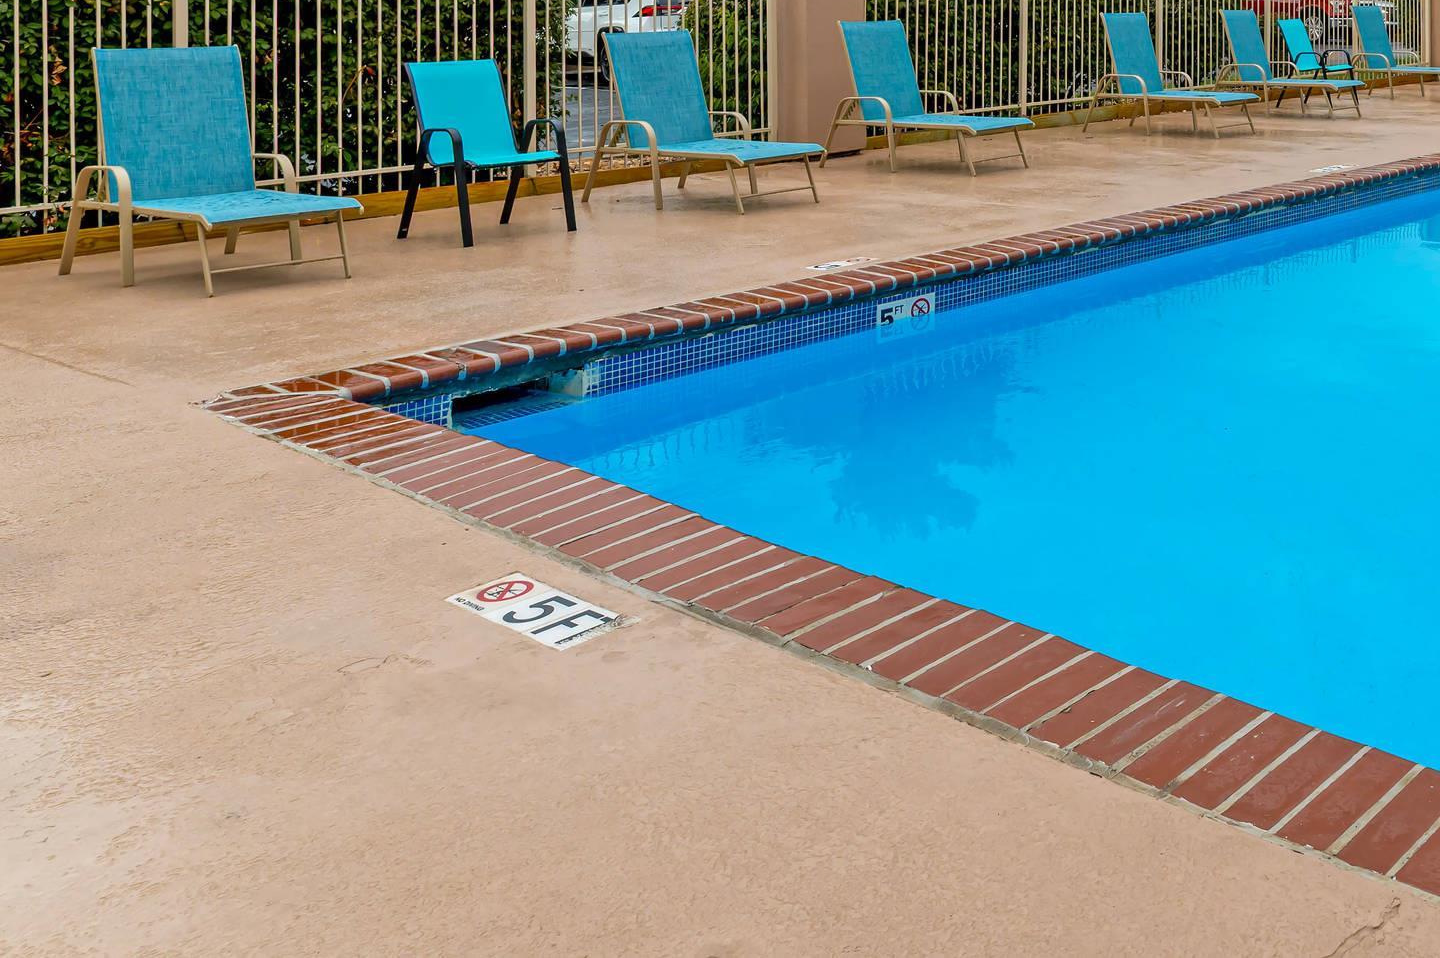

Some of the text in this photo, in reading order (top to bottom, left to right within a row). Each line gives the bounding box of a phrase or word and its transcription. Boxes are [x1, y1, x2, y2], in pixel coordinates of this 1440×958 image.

[880, 304, 904, 326] 5 FT
[502, 595, 577, 624] 5
